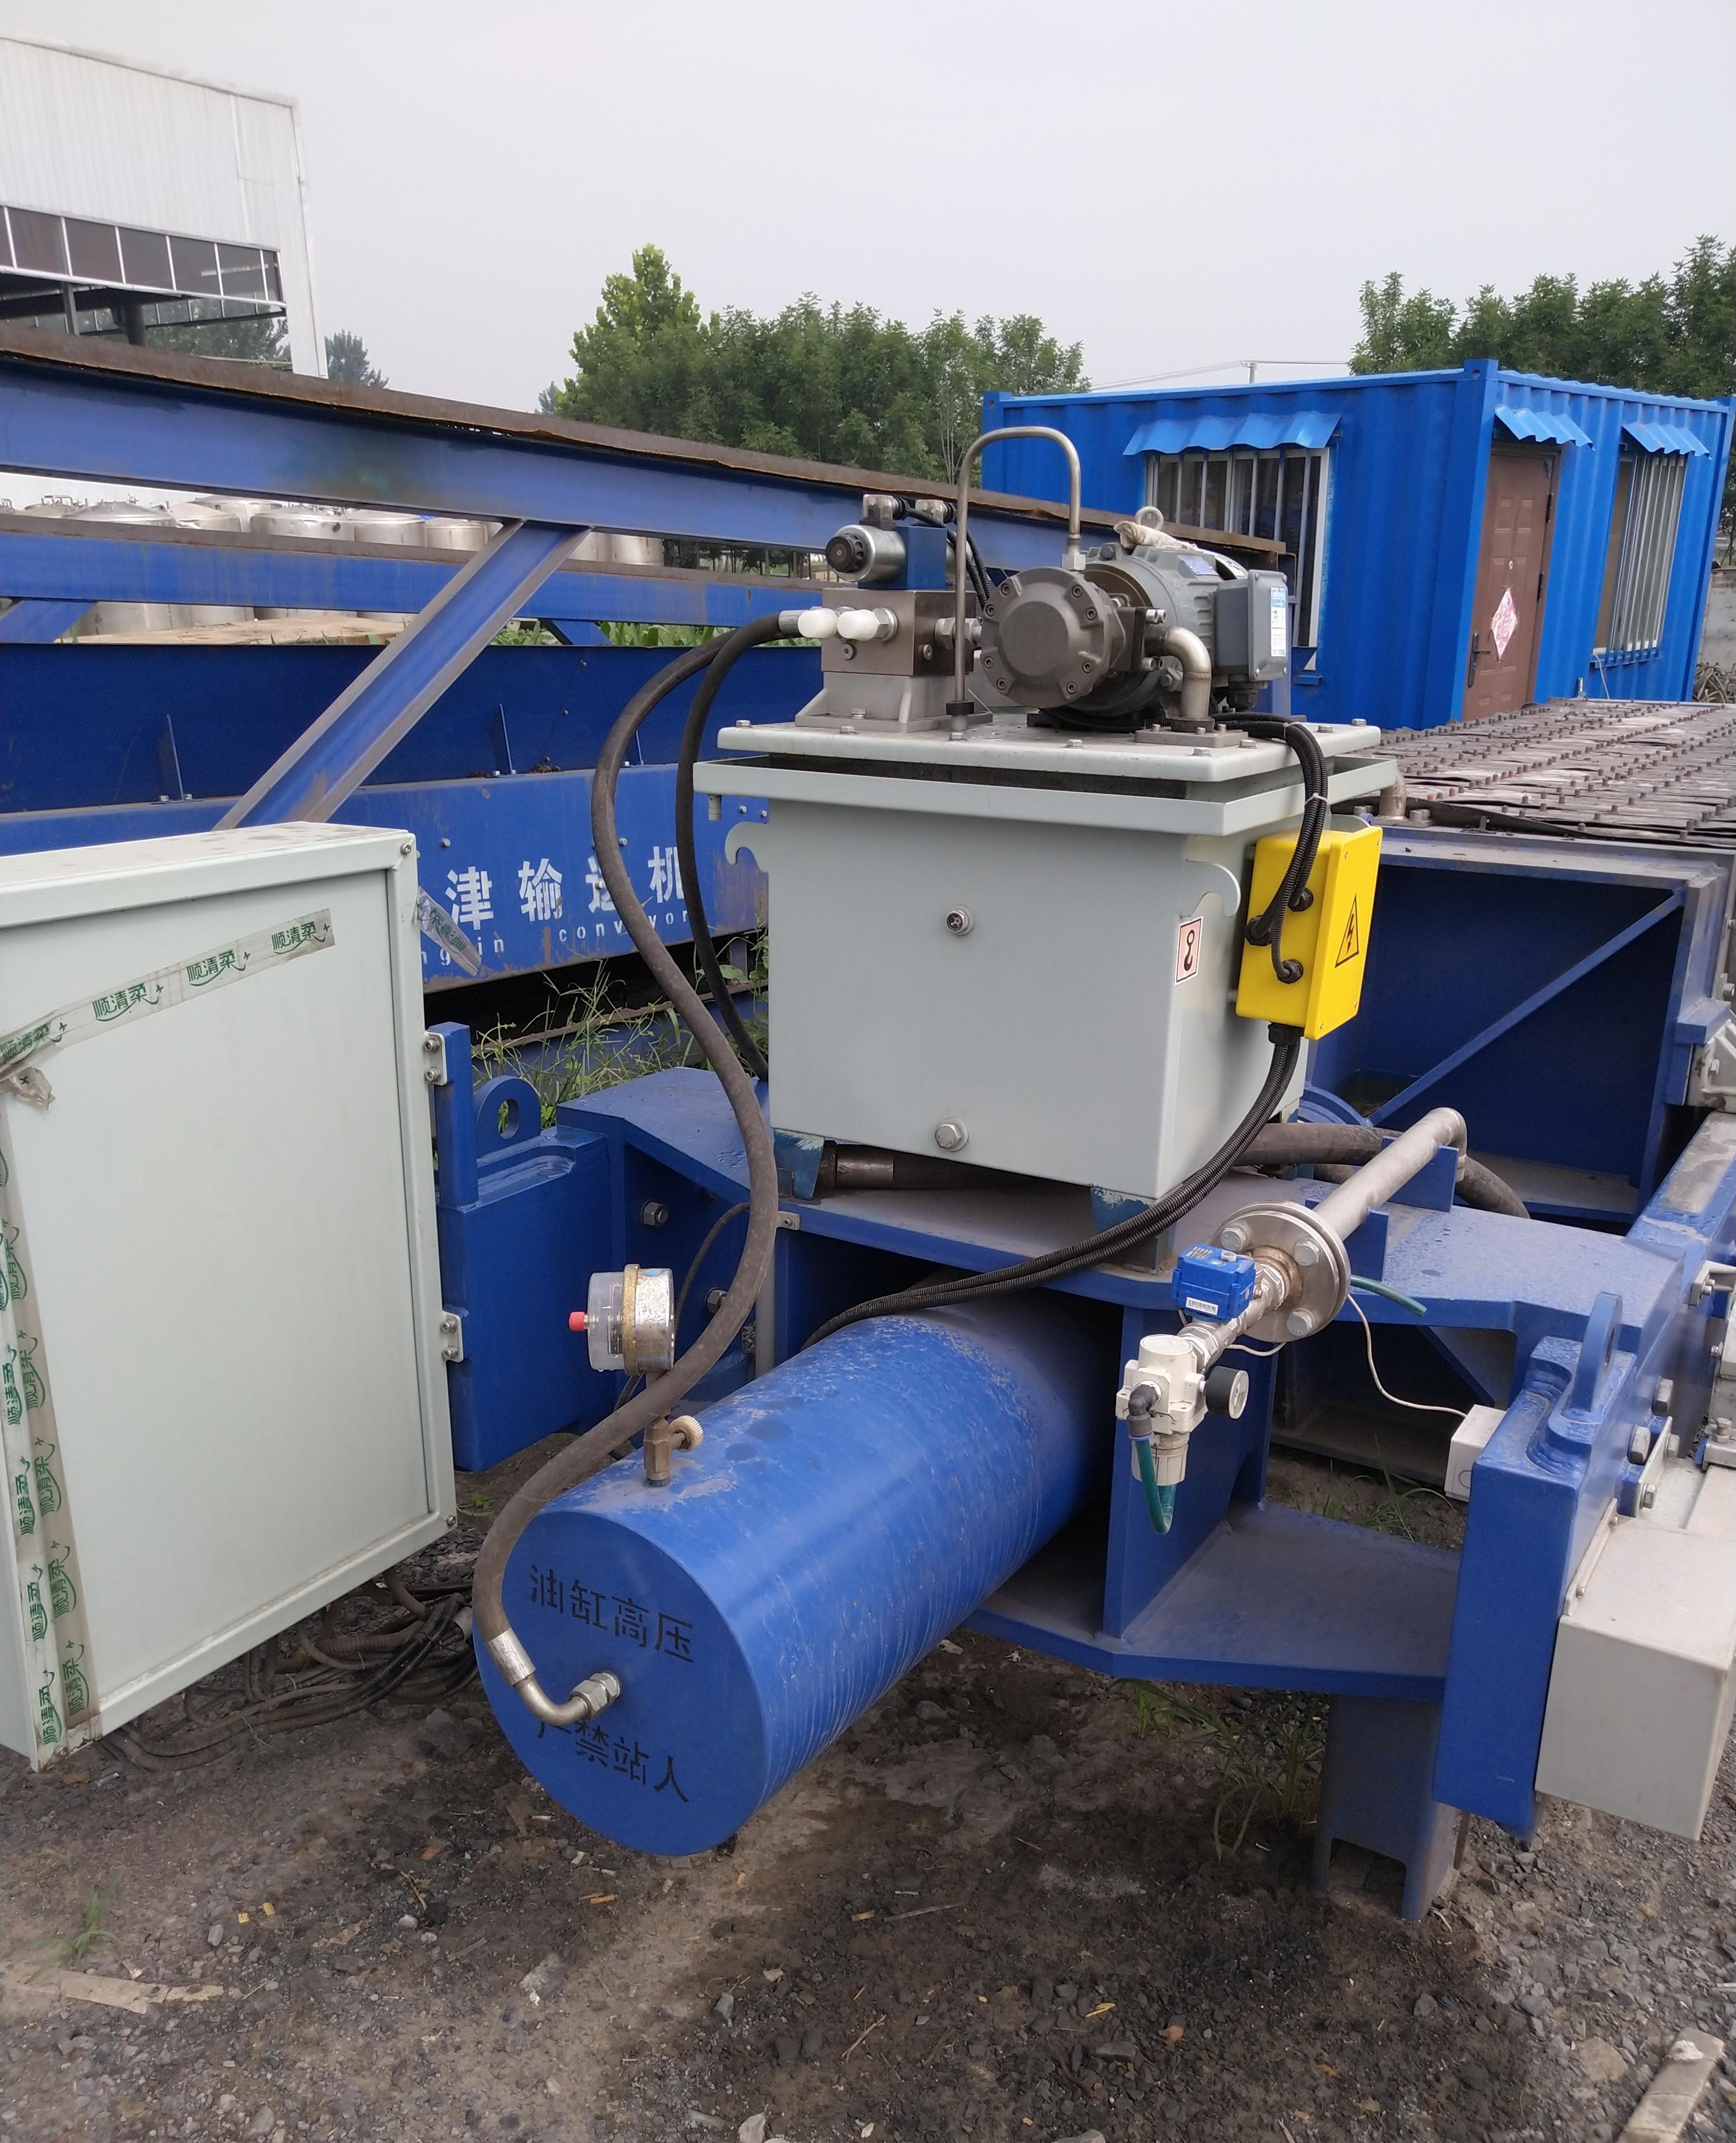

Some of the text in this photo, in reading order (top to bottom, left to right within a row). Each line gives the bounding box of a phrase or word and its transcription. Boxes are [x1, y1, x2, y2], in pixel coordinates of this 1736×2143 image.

[271, 921, 316, 951] 顺清柔
[559, 909, 688, 942] convyor
[186, 950, 236, 982] 顺清柔
[92, 982, 148, 1018] 顺清柔
[529, 1563, 693, 1664] 油缸高压
[62, 1657, 84, 1716] 顺清柔
